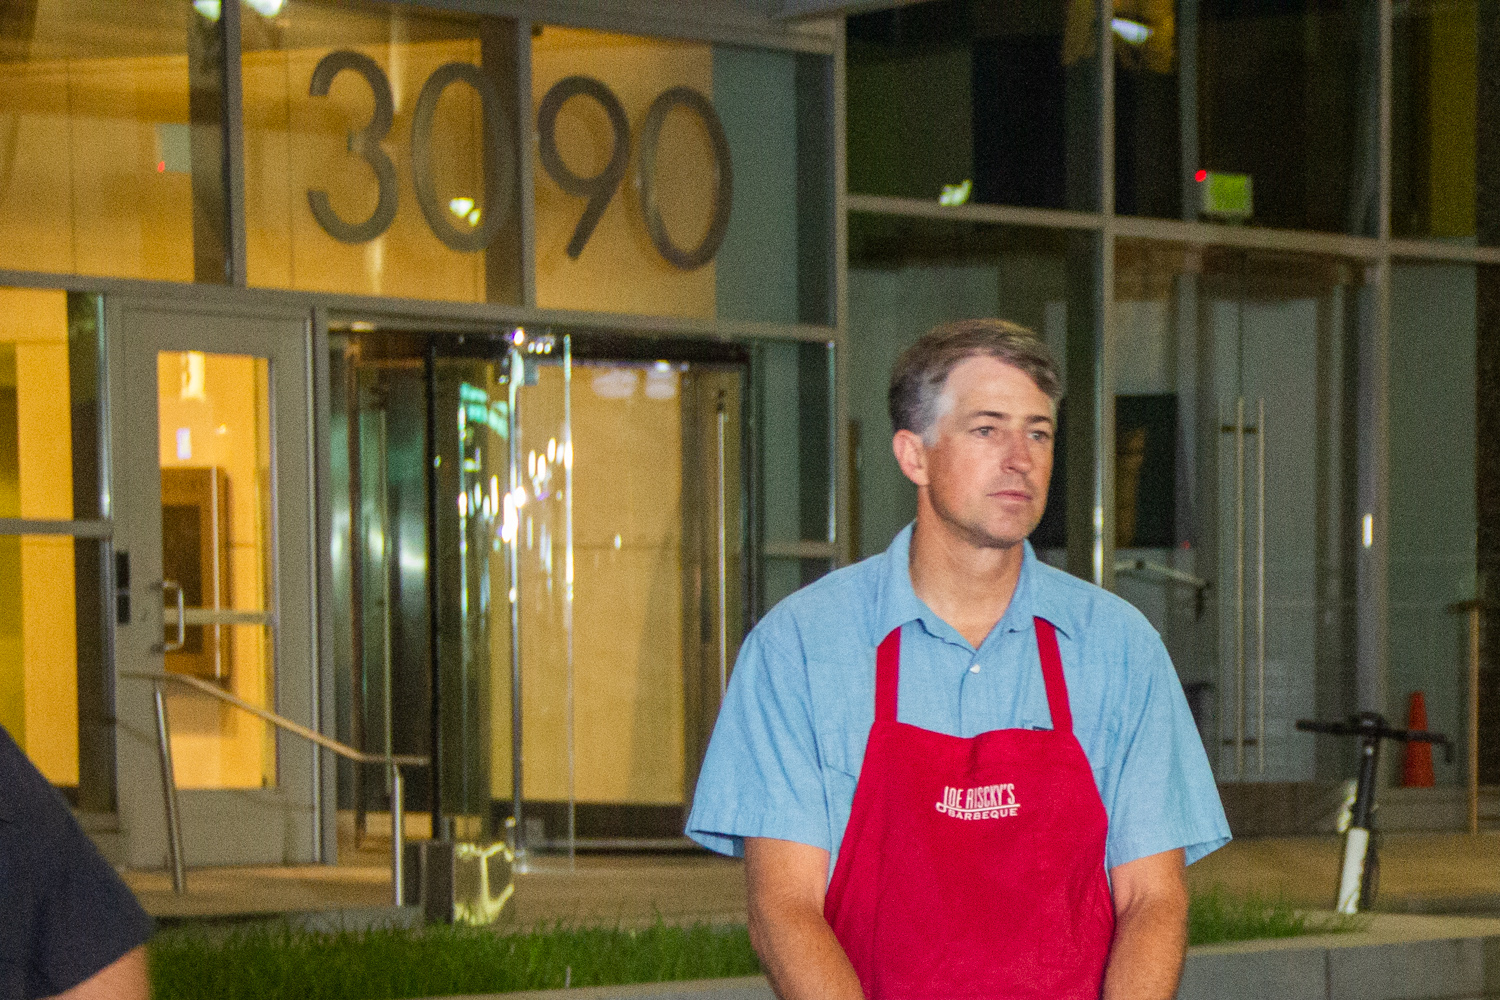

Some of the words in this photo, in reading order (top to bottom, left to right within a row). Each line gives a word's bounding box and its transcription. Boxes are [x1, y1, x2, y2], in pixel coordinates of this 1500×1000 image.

[306, 50, 733, 271] 3090
[936, 785, 965, 812] JOE
[965, 783, 1016, 810] RISCKY'S
[947, 807, 1018, 820] BARBEQUE
